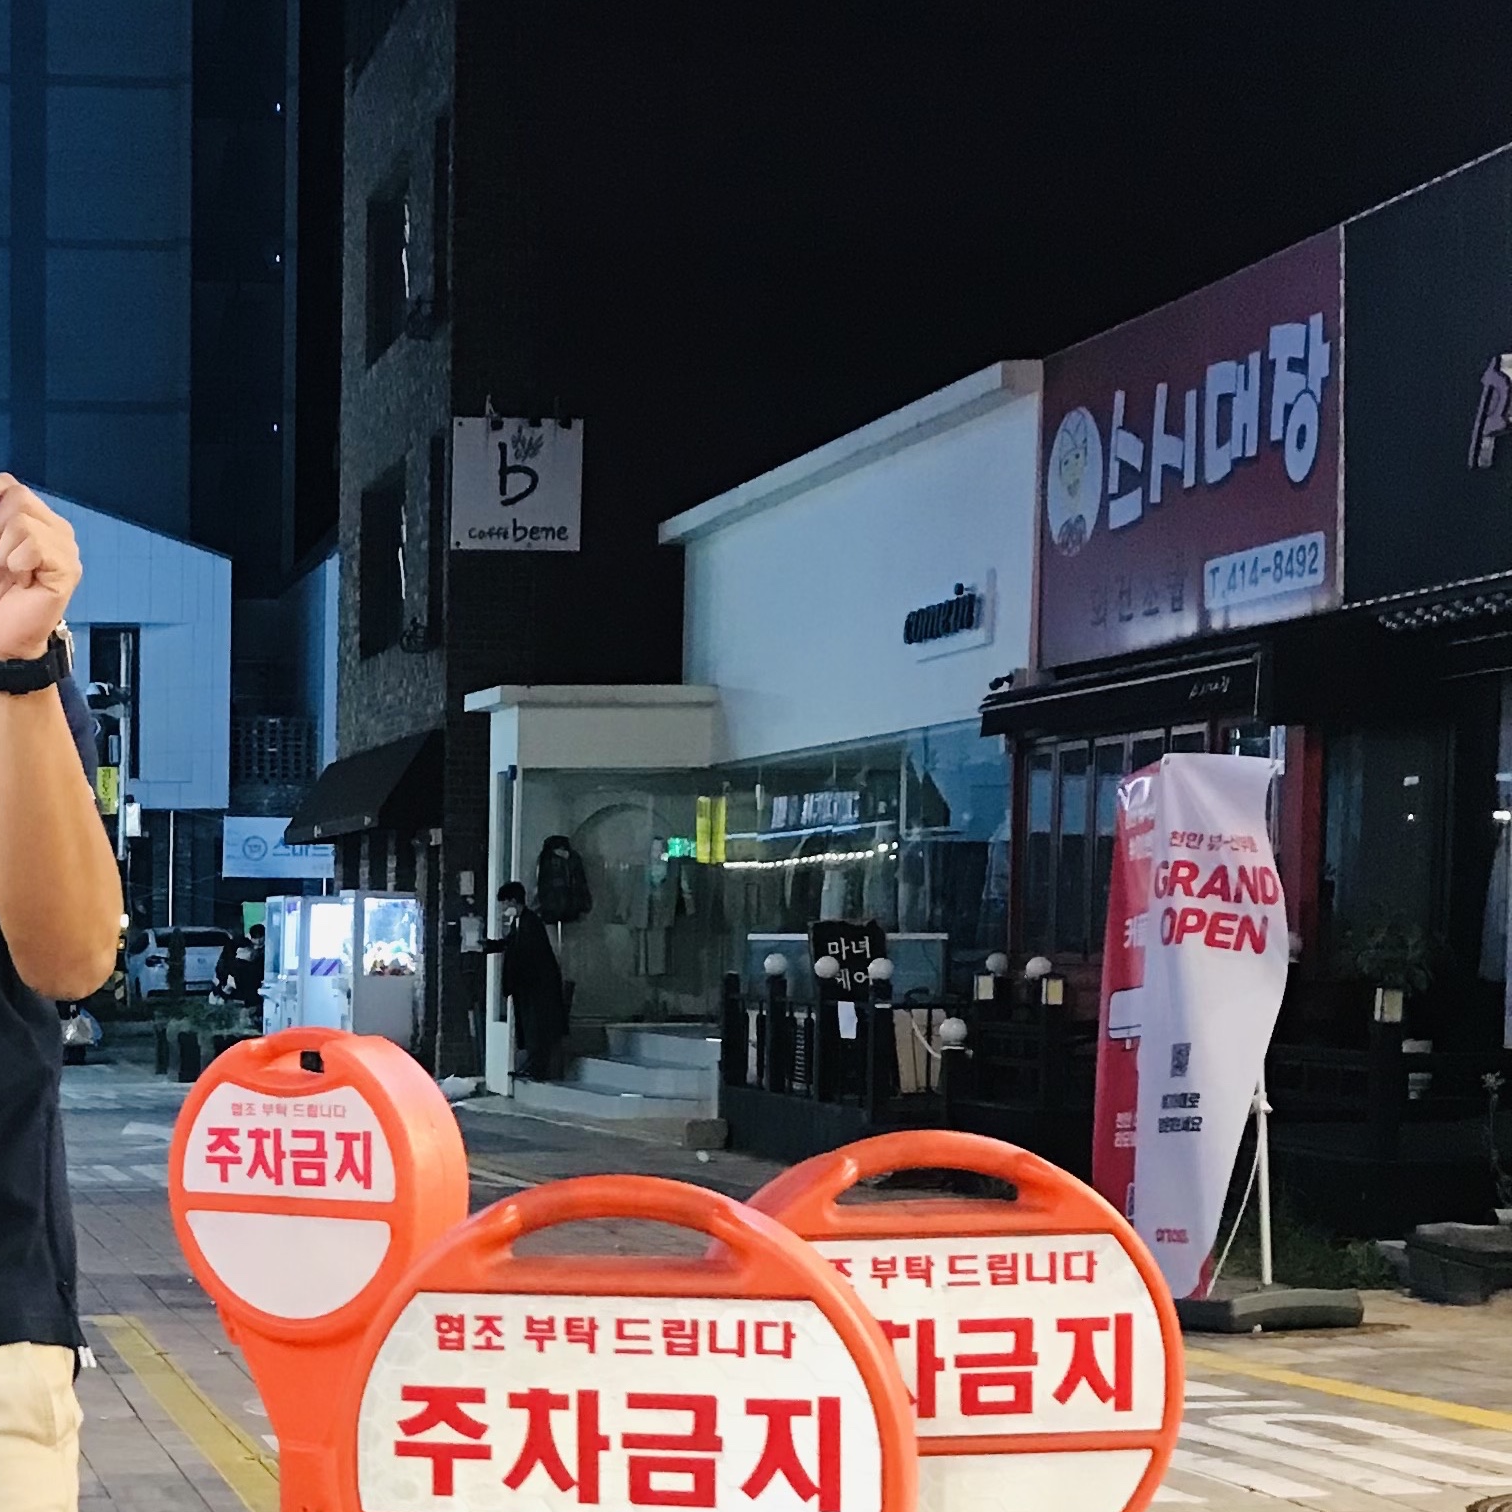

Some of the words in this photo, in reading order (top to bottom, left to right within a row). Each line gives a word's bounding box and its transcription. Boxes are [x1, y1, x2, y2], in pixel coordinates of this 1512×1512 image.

[1108, 312, 1330, 529] 스시대장
[512, 517, 569, 542] bene
[1209, 541, 1318, 599] T.414-8492
[1154, 860, 1279, 905] GRAND
[828, 936, 871, 961] 마녀
[1160, 907, 1268, 954] OPEN
[231, 1102, 256, 1117] 협조
[262, 1102, 287, 1117] 부탁
[292, 1103, 347, 1119] 드립니다
[205, 1127, 373, 1190] 주차금지
[869, 1253, 935, 1289] 부탁
[947, 1250, 1098, 1287] 드립니다
[434, 1313, 506, 1353] 협조
[524, 1314, 600, 1354] 부탁
[613, 1316, 797, 1359] 드립니다
